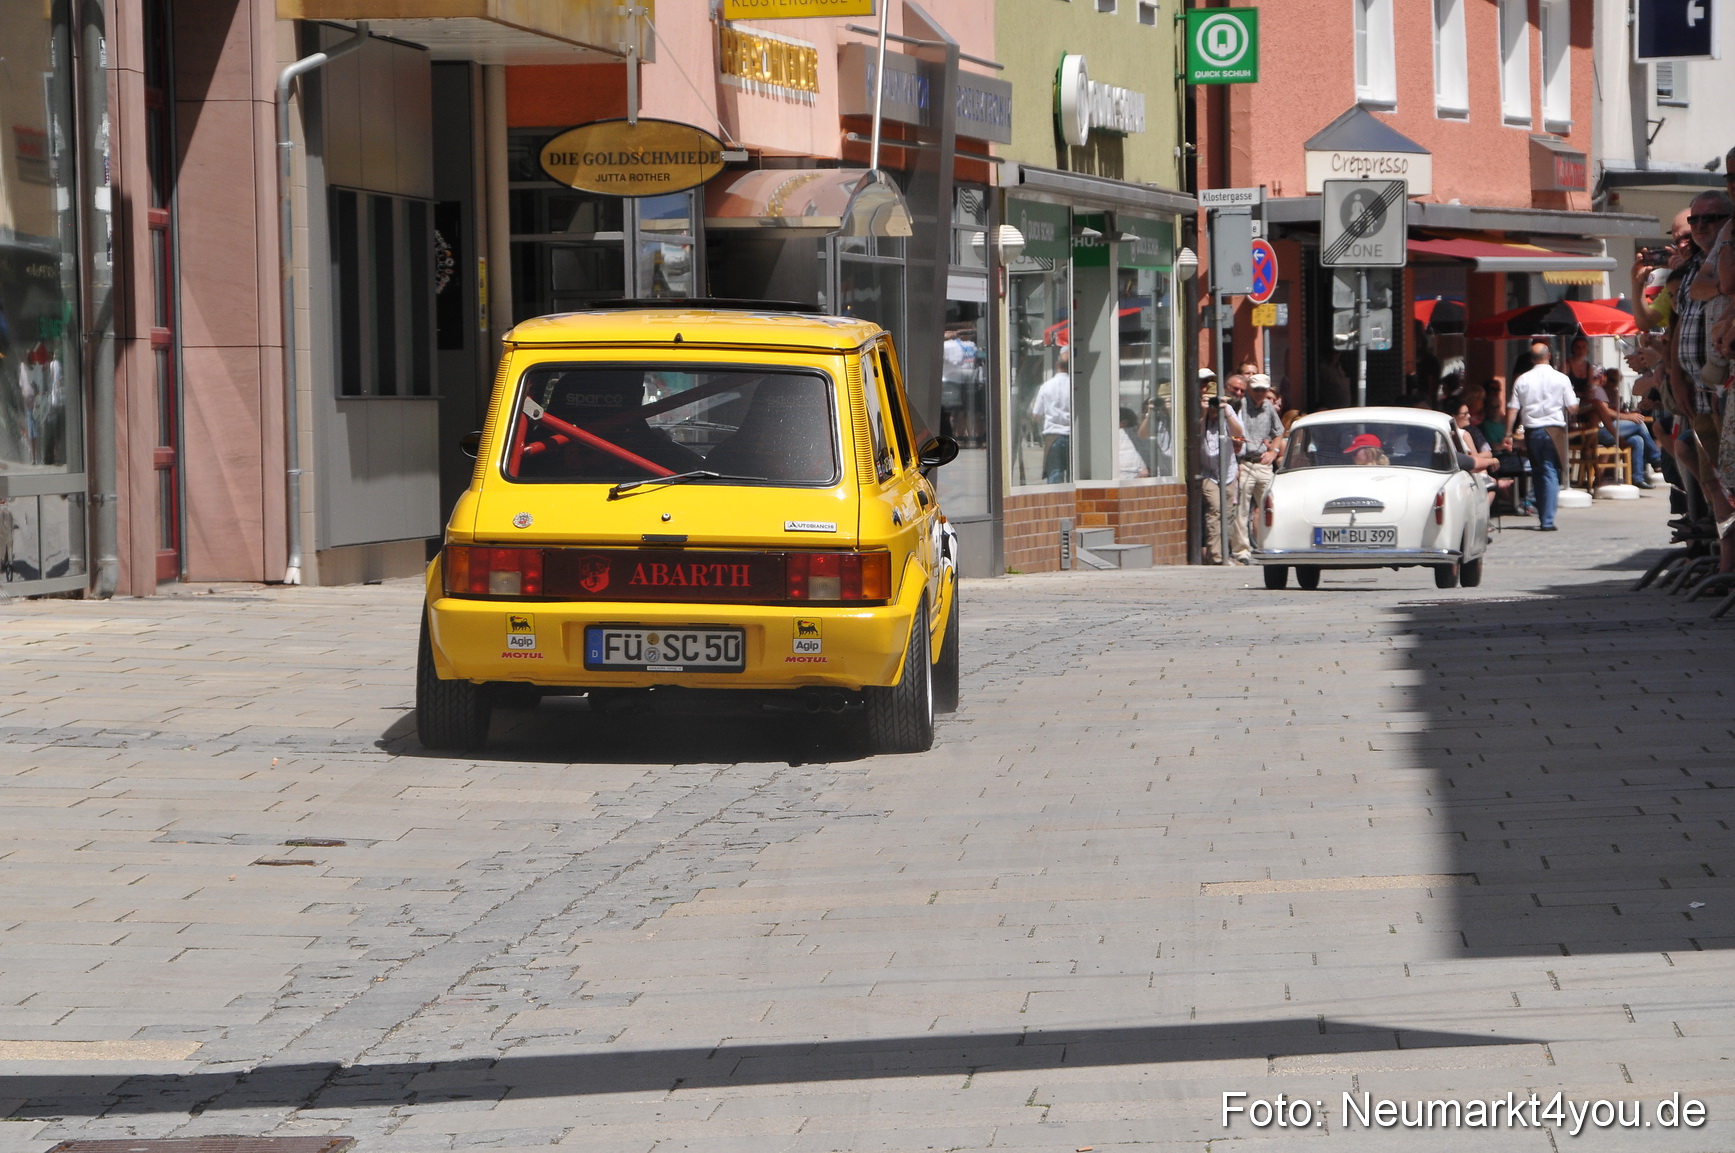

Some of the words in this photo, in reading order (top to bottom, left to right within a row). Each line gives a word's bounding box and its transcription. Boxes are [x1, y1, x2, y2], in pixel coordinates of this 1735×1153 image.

[549, 152, 579, 165] DIE
[583, 151, 720, 165] GOLDSCHMIEDE
[1331, 153, 1408, 178] Creppresso
[595, 173, 626, 182] JUTTA
[629, 173, 670, 181] ROTHER
[1202, 192, 1252, 203] Klostergasse
[1343, 244, 1383, 257] ZONE
[566, 392, 623, 406] sparco
[1323, 530, 1340, 543] NM
[1349, 530, 1367, 543] BU
[1370, 530, 1395, 543] 399
[629, 563, 751, 587] ABARTH
[510, 636, 533, 647] Agip
[604, 633, 642, 660] FÜ
[663, 634, 699, 661] SC
[705, 634, 740, 662] 50
[796, 640, 819, 651] Agip
